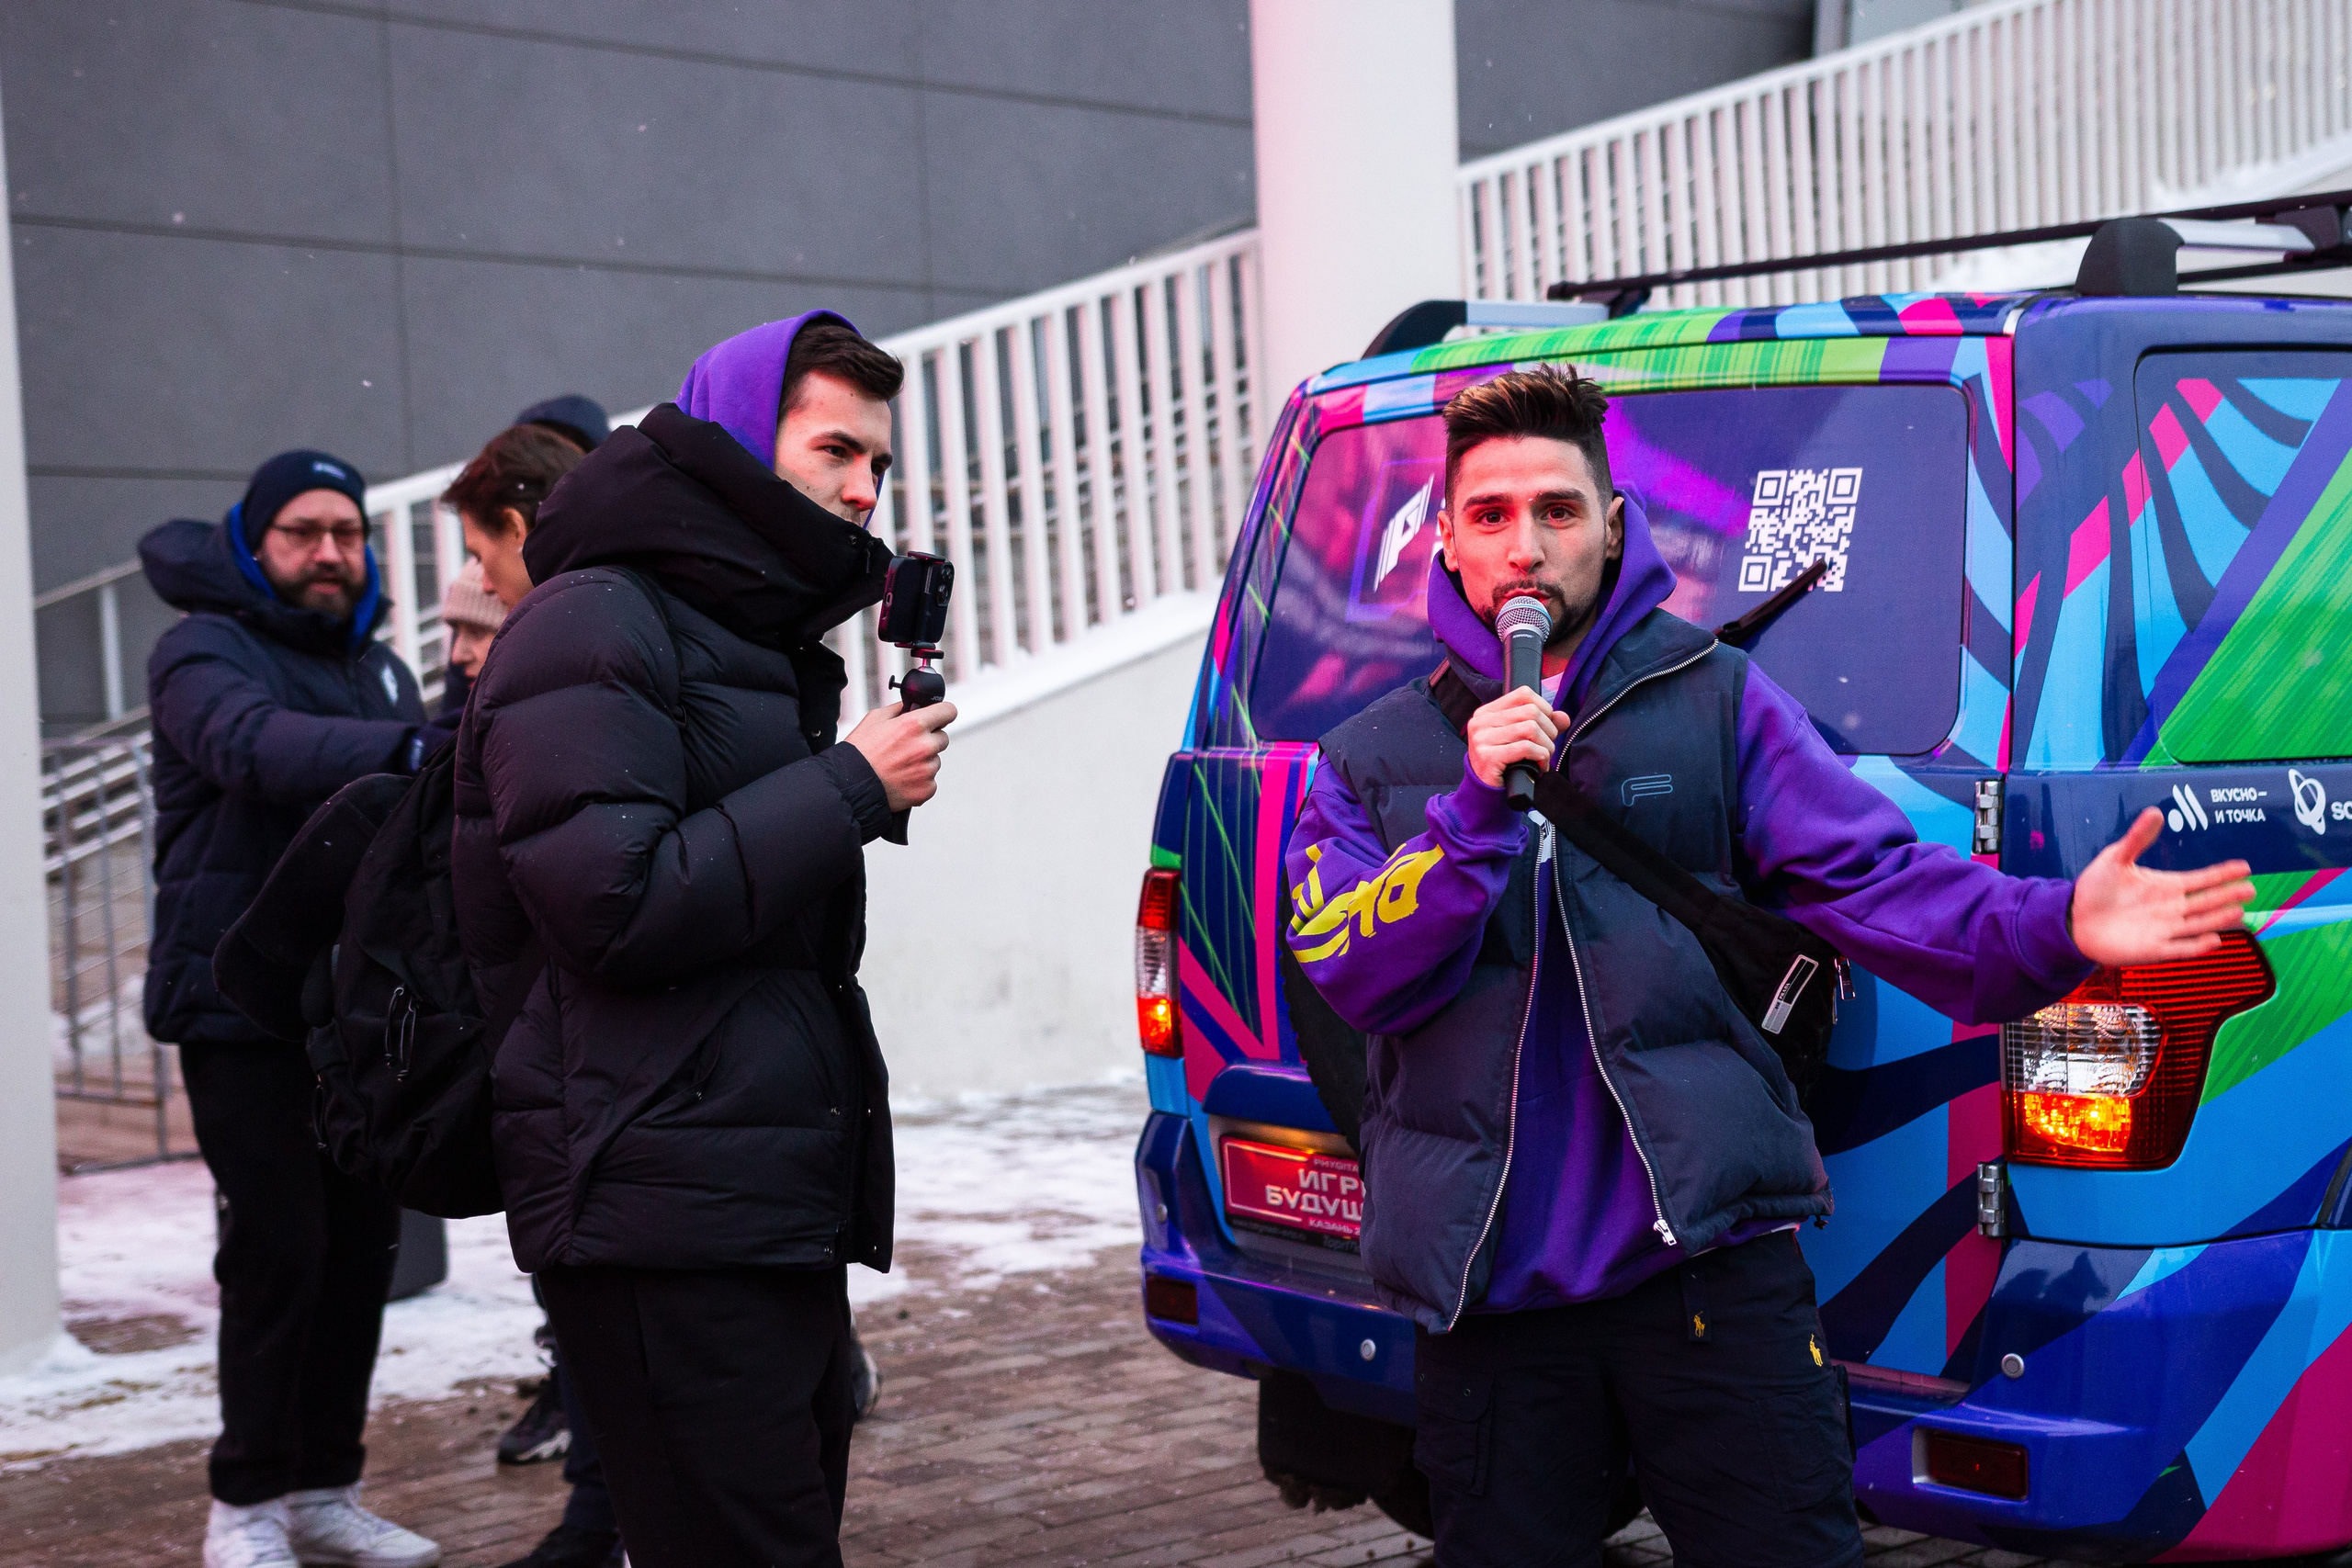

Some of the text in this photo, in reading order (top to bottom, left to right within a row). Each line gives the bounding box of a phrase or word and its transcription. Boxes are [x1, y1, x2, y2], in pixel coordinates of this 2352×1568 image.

[2215, 808, 2267, 823] И ТОЧКА
[1298, 1168, 1366, 1198] ИГР
[1308, 1218, 1354, 1234] КАЗАНЬ
